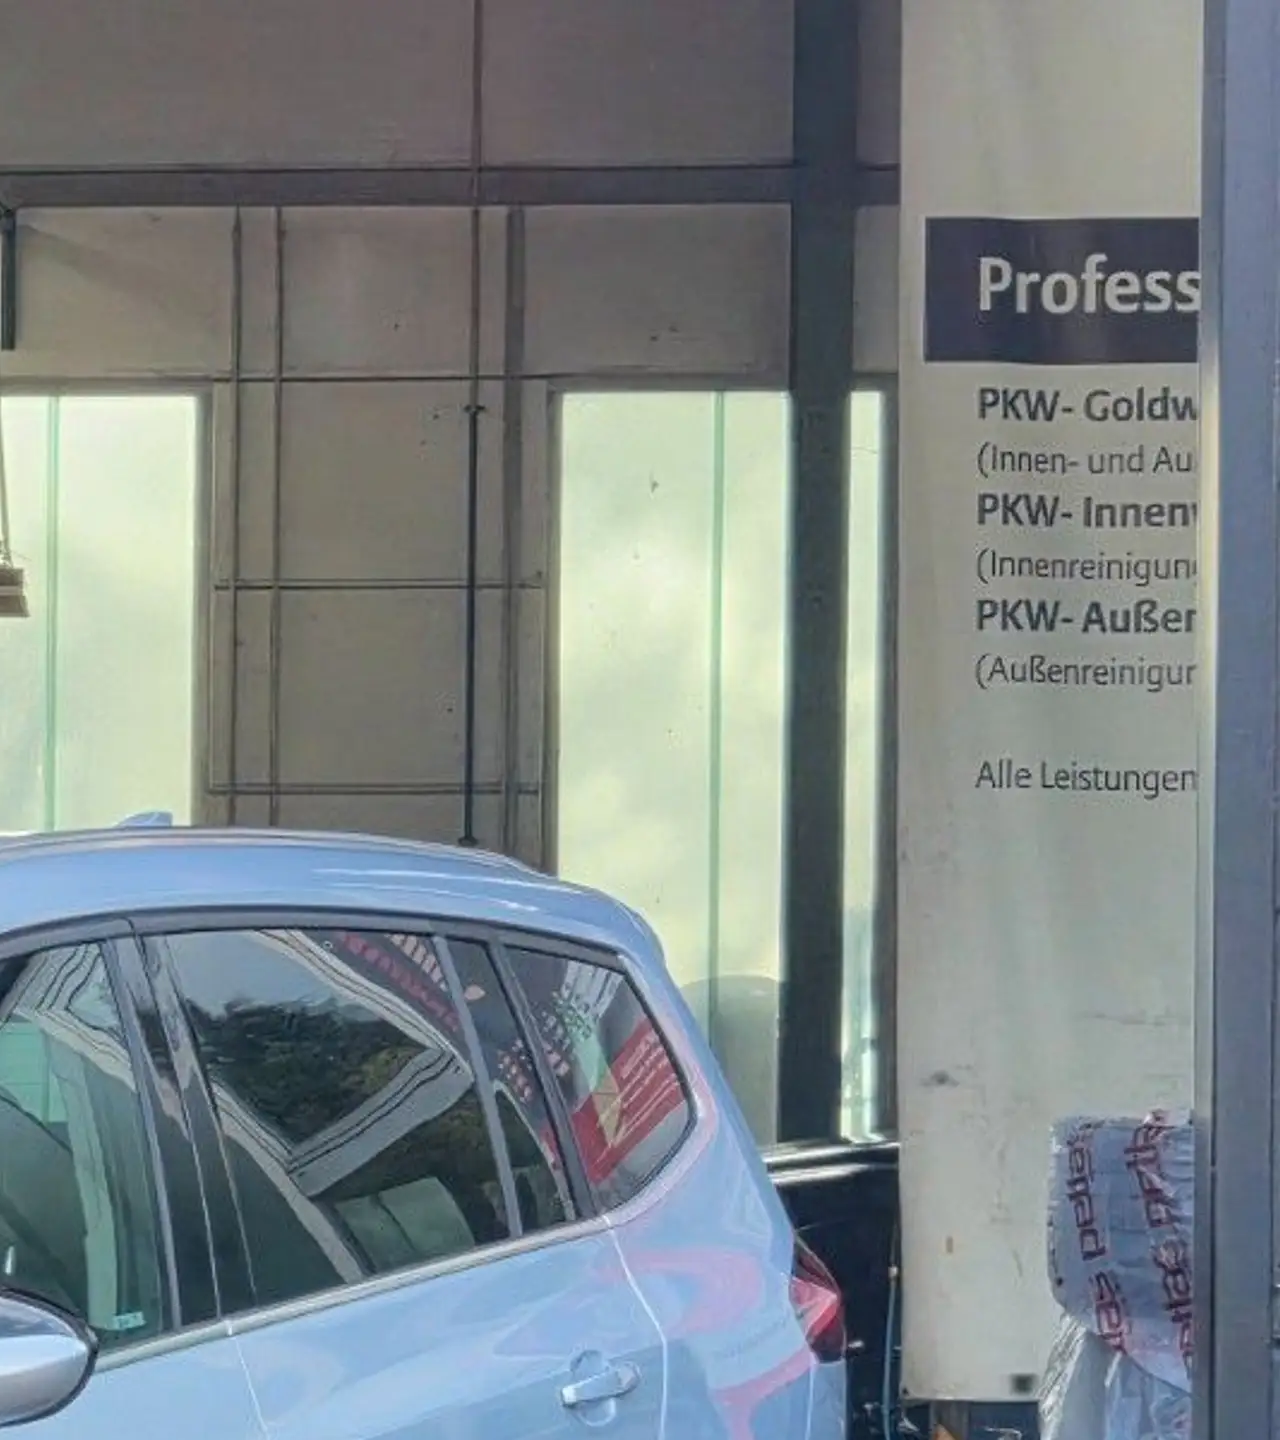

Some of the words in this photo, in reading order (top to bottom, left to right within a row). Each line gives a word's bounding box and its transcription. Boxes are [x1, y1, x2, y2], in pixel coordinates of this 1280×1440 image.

[979, 253, 1202, 314] Profess
[978, 387, 1074, 421] PKW-
[977, 442, 1079, 478] (Innen-
[1088, 445, 1144, 473] und
[977, 493, 1073, 527] PKW-
[1083, 496, 1197, 528] Innen
[977, 547, 1197, 587] (Innenreinigun
[977, 599, 1073, 632] PKW-
[975, 758, 1032, 789] Alle
[1041, 761, 1198, 800] Leistungen
